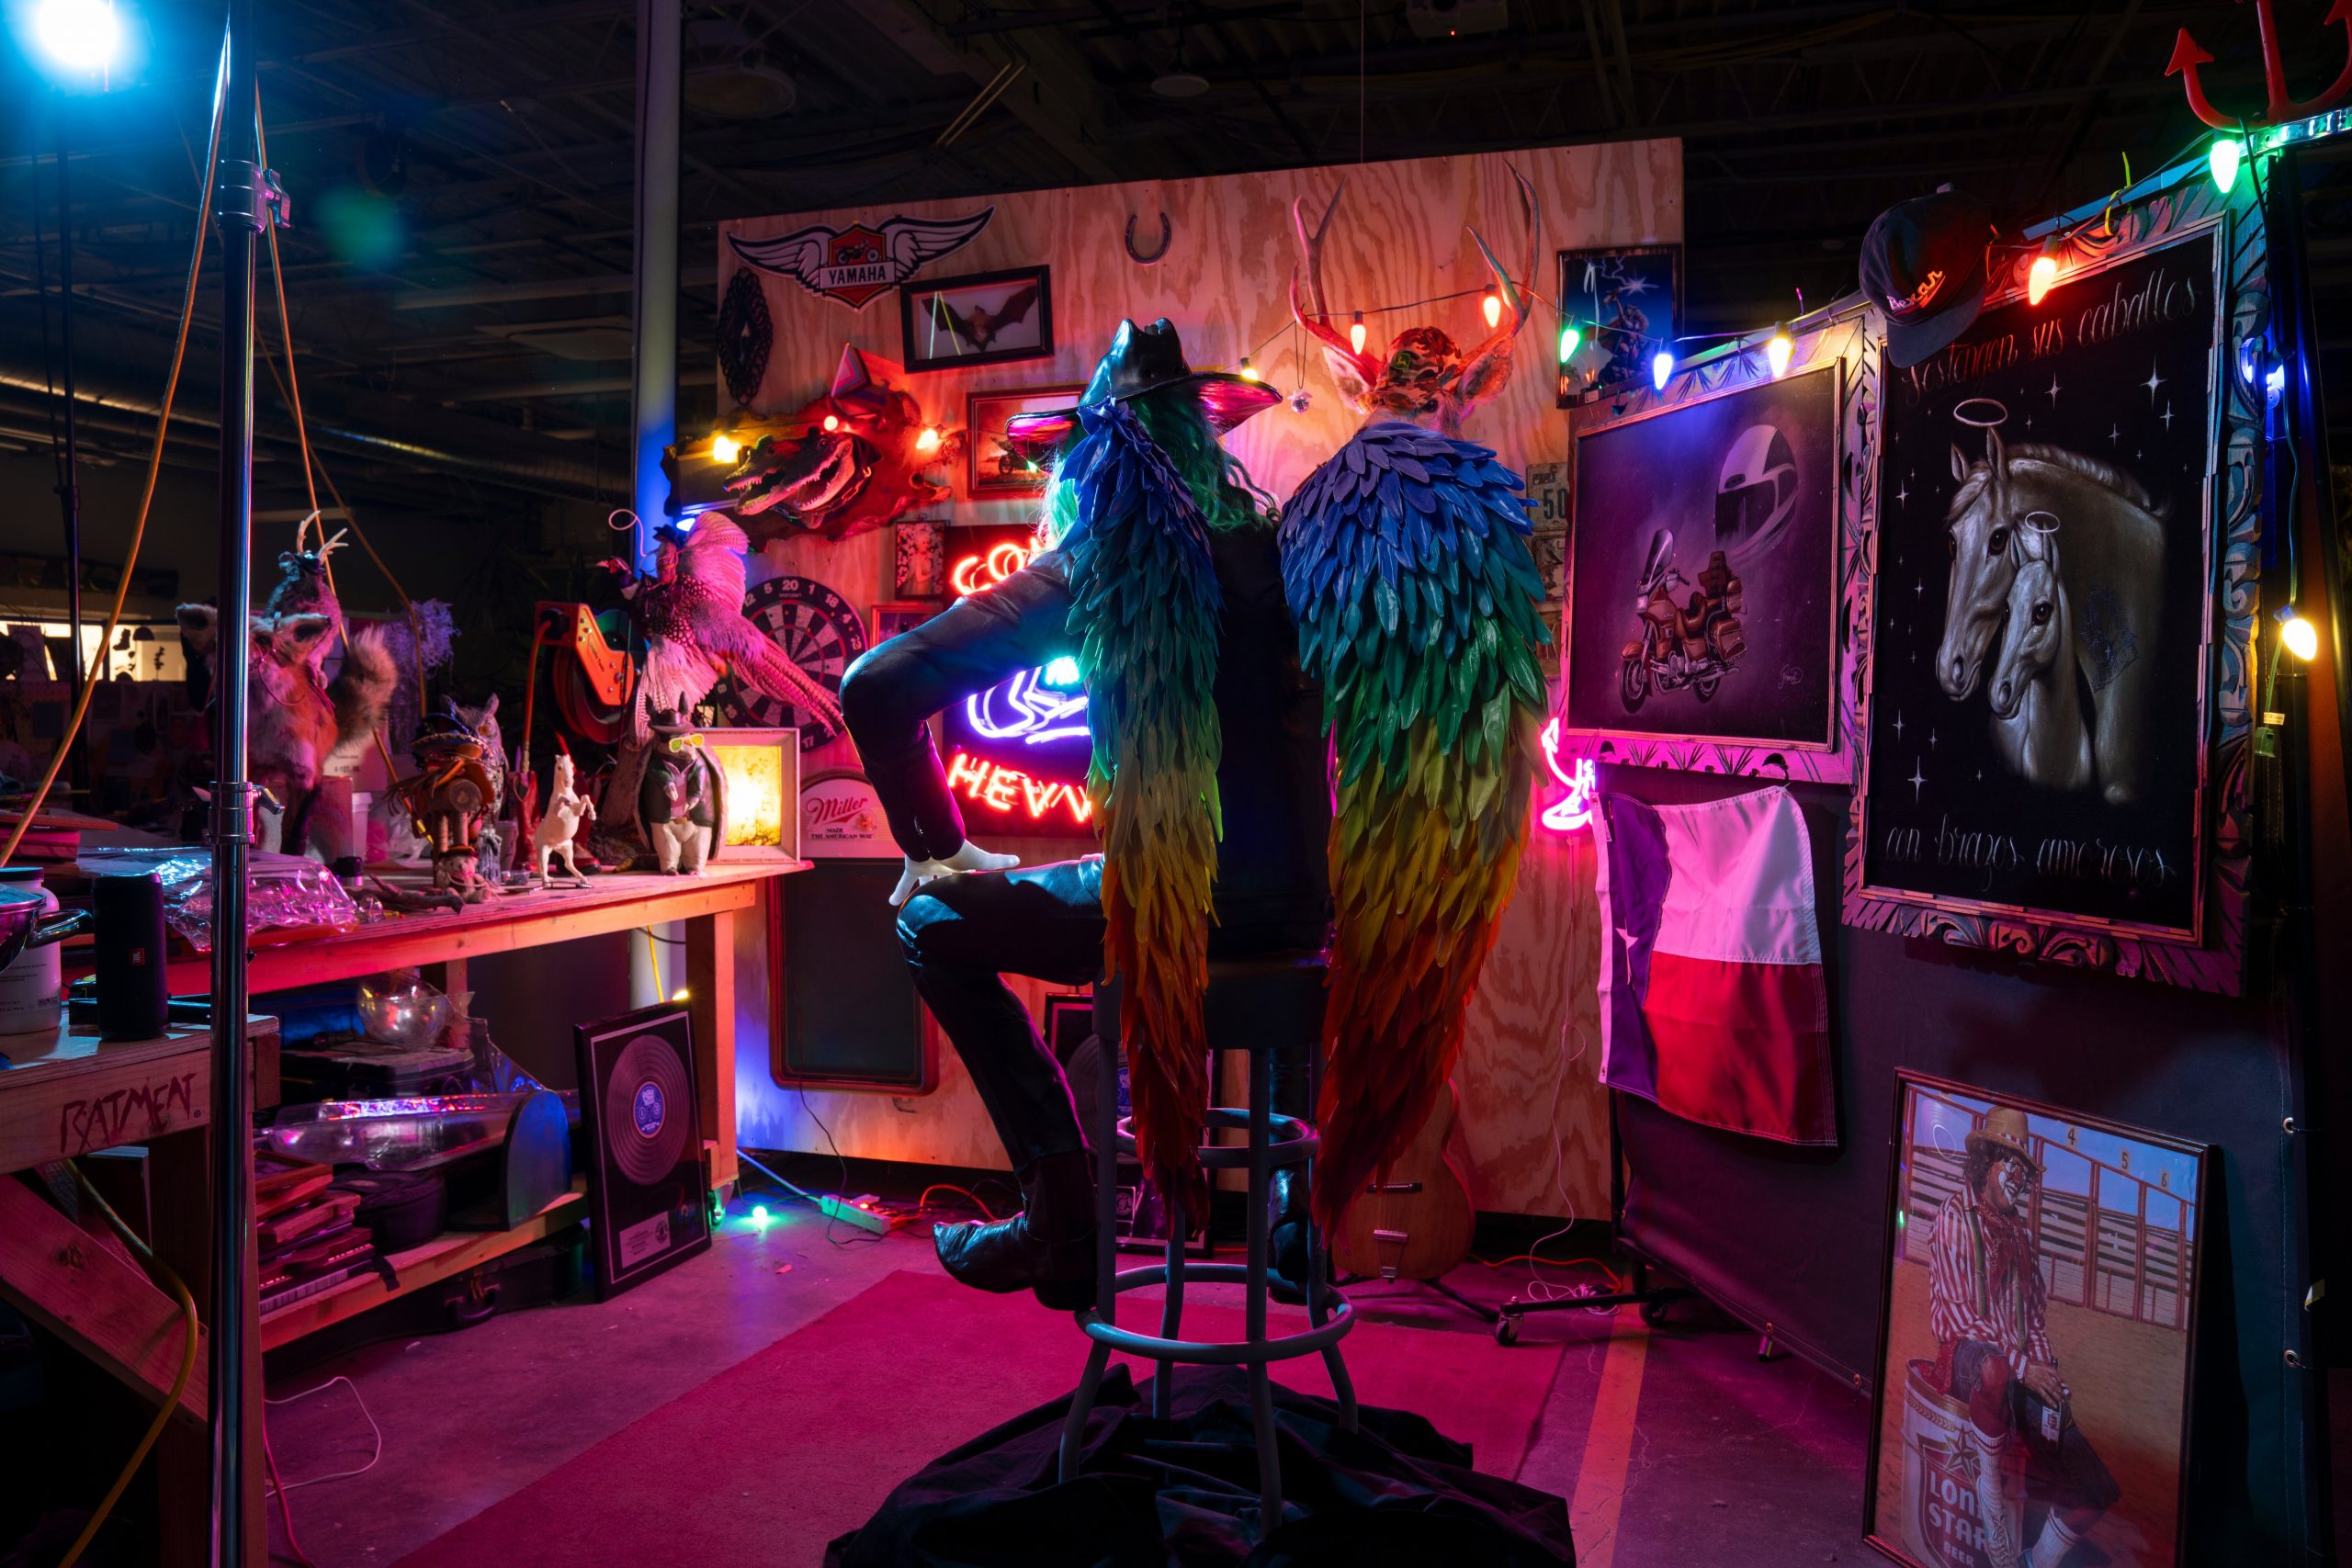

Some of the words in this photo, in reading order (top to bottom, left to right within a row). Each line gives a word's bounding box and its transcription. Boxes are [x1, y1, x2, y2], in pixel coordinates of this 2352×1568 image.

[829, 265, 887, 285] YAMAHA
[1886, 270, 1943, 310] Bexar
[2029, 318, 2065, 361] sus
[2078, 267, 2199, 347] caballos
[763, 581, 774, 594] 5
[782, 579, 799, 591] 20
[808, 583, 816, 595] 1
[825, 593, 839, 608] 18
[802, 736, 816, 749] 17
[807, 796, 868, 824] Miller
[1886, 827, 1921, 862] con
[1935, 813, 2026, 892] brazos
[2036, 837, 2177, 887] amorosos
[2068, 1128, 2076, 1145] 4
[2120, 1151, 2129, 1169] 5
[2160, 1173, 2168, 1188] 6
